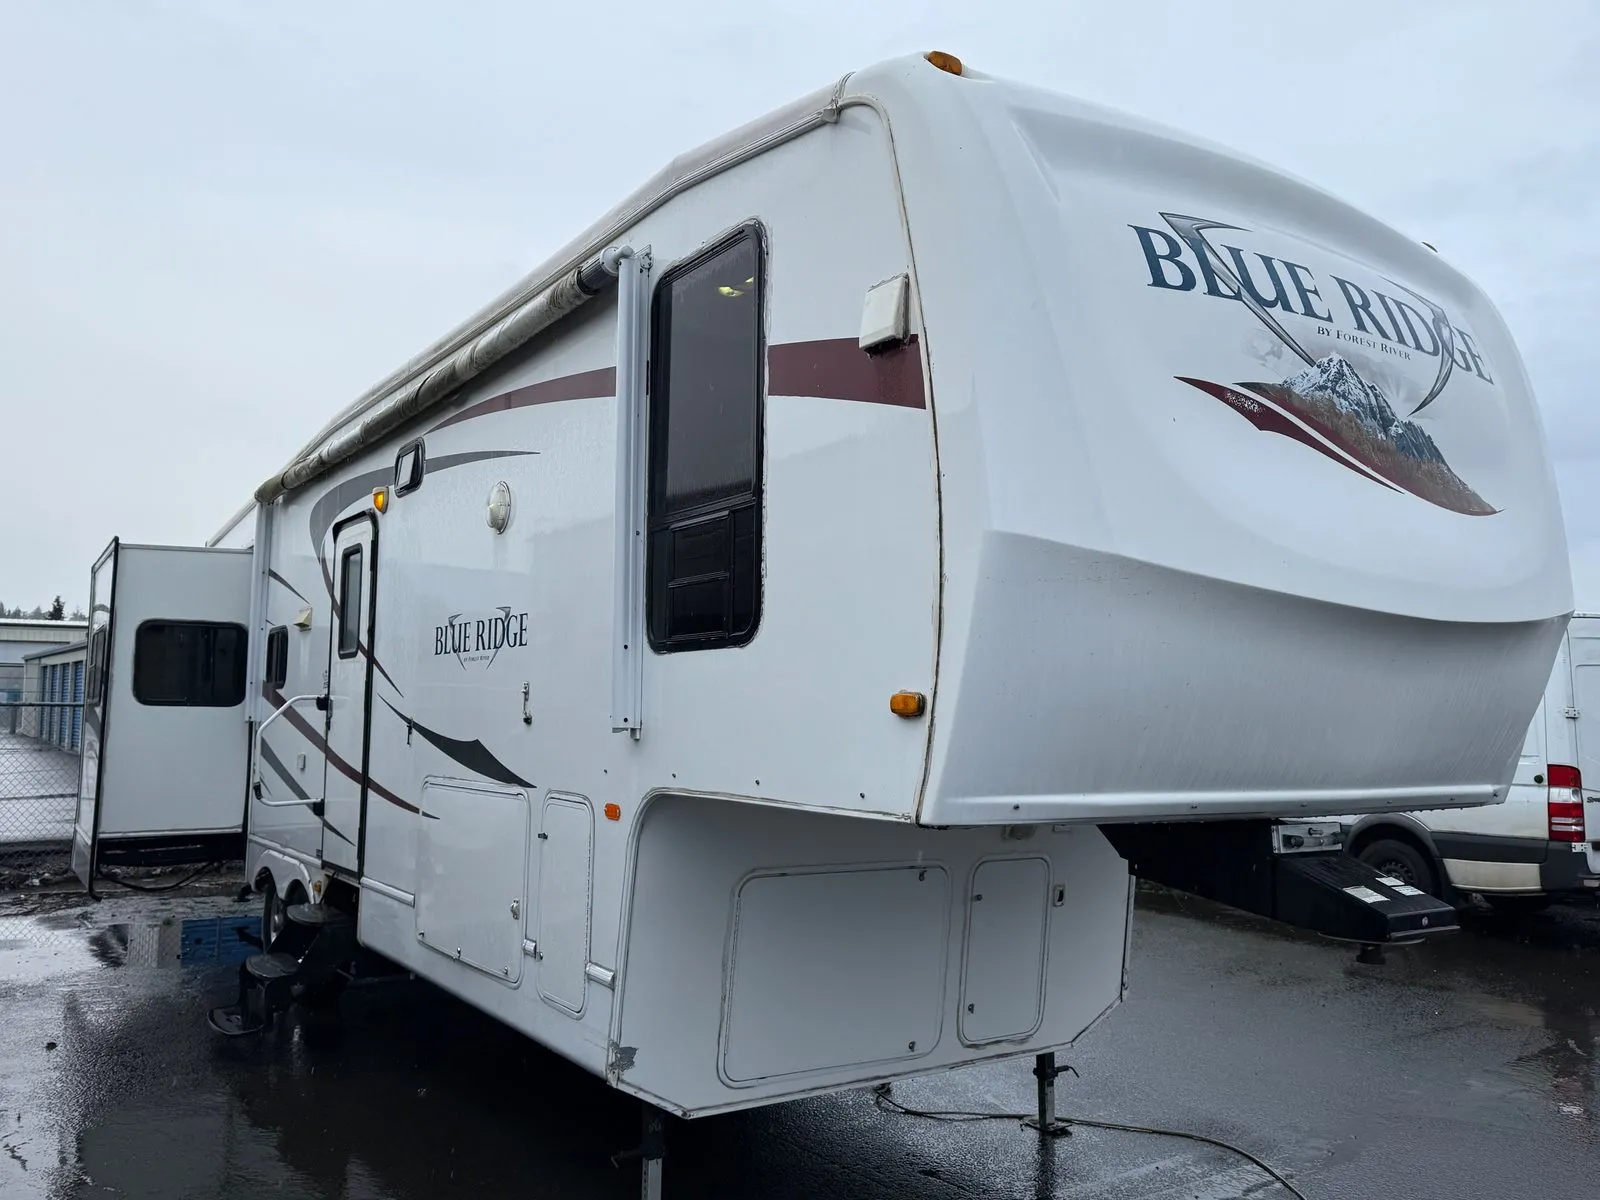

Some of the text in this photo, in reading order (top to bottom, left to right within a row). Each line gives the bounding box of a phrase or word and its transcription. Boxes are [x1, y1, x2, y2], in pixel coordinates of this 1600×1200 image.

[1127, 224, 1494, 385] BLUE RIDGE
[1317, 326, 1411, 361] BY FOREST RIVER
[434, 613, 528, 655] BLUE RIDGE
